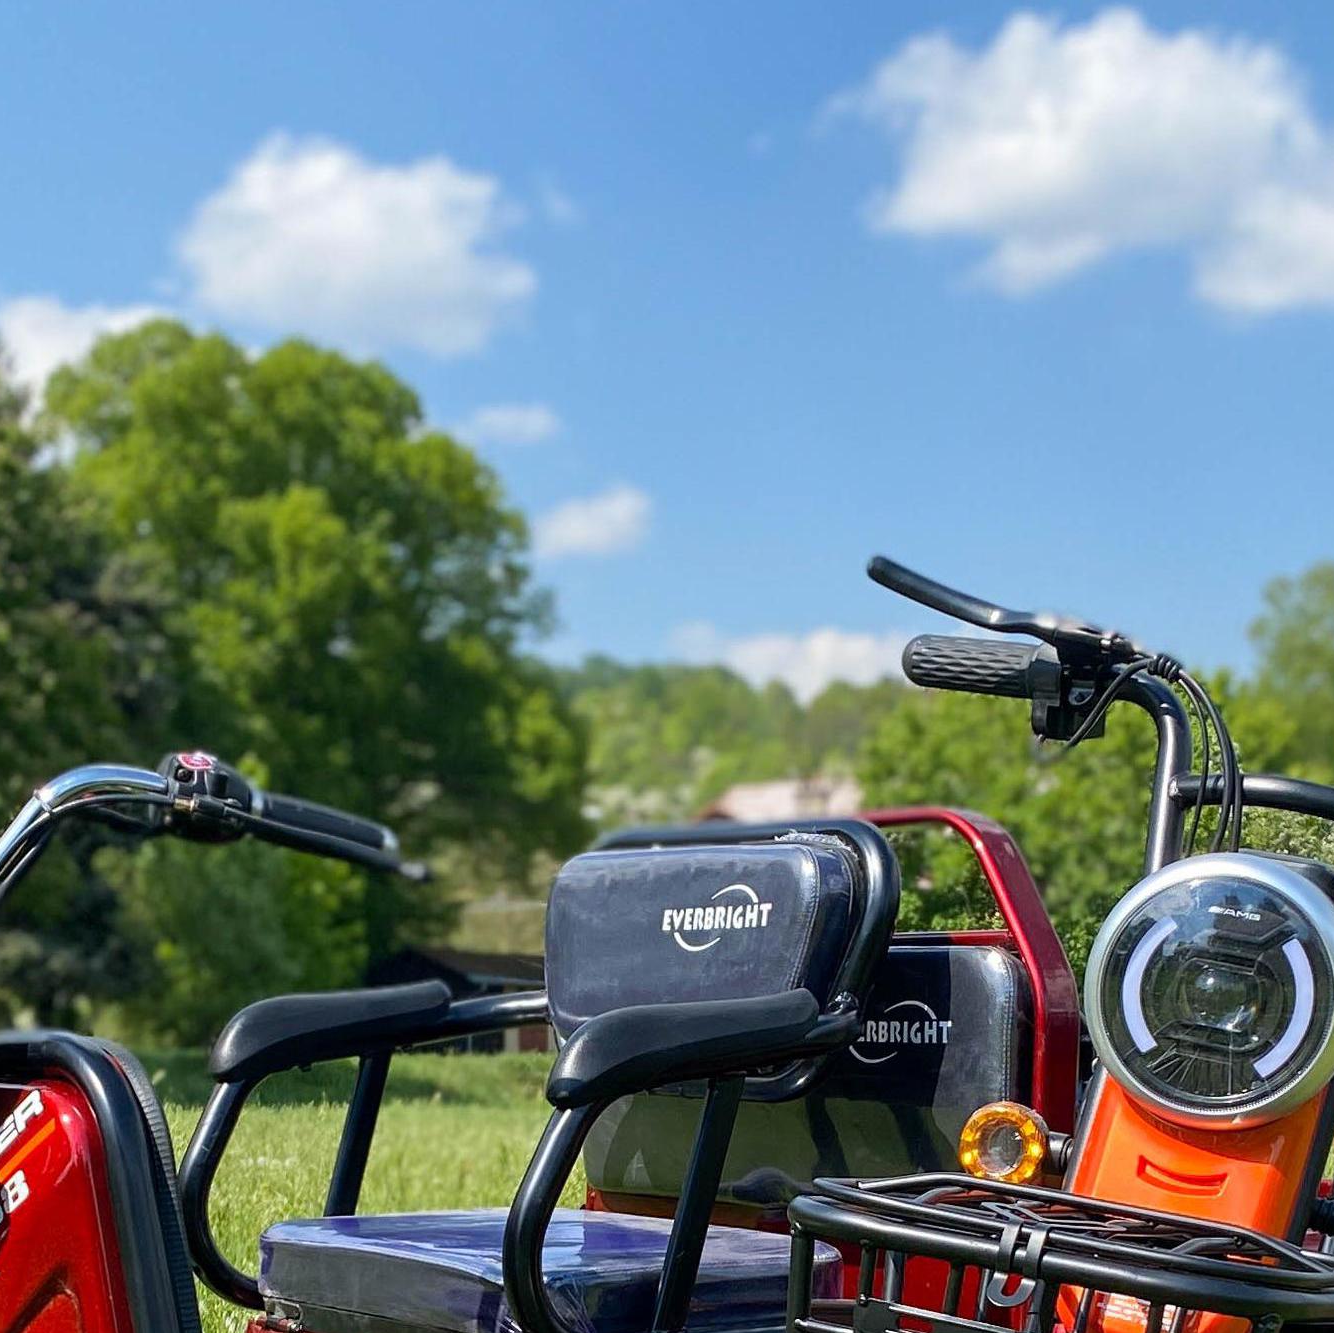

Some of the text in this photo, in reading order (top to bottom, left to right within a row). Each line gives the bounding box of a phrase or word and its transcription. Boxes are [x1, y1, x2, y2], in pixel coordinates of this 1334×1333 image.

[662, 903, 772, 931] EVERBRIGHT
[1223, 907, 1261, 921] AMG
[857, 1020, 953, 1044] RBRIGHT
